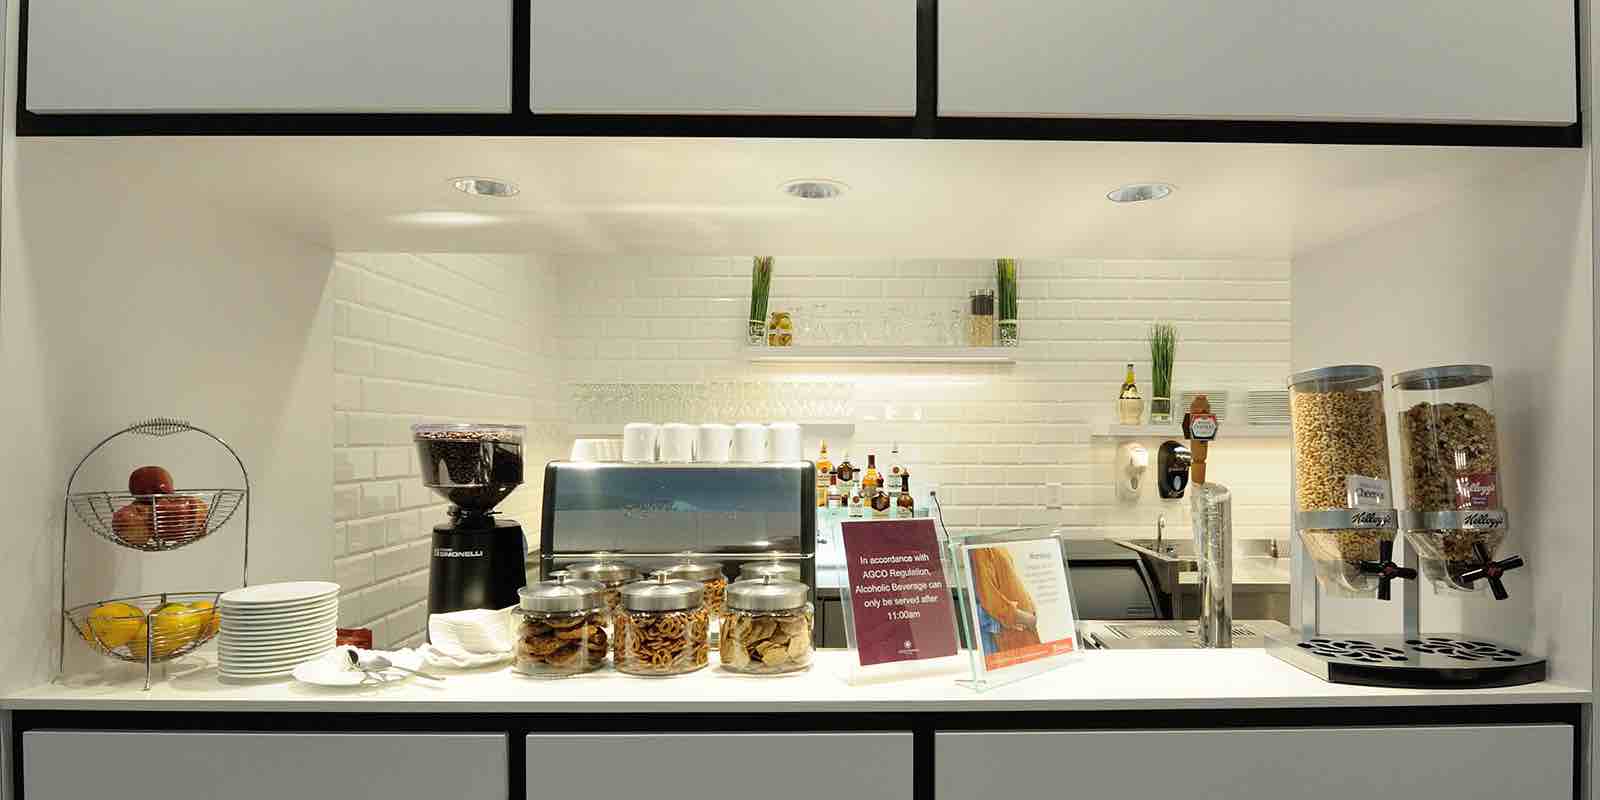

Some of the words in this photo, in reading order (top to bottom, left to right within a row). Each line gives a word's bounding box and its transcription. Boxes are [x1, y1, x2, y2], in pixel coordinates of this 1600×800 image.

[860, 557, 869, 565] In
[870, 555, 913, 564] accordance
[914, 553, 929, 562] with
[863, 570, 888, 579] AGCO
[890, 568, 931, 579] Regulation,
[856, 584, 891, 594] Alcoholic
[892, 582, 928, 593] Beverage
[864, 599, 881, 609] only
[882, 598, 893, 607] be
[894, 596, 920, 606] served
[921, 595, 938, 603] after
[887, 611, 920, 620] 11:00am
